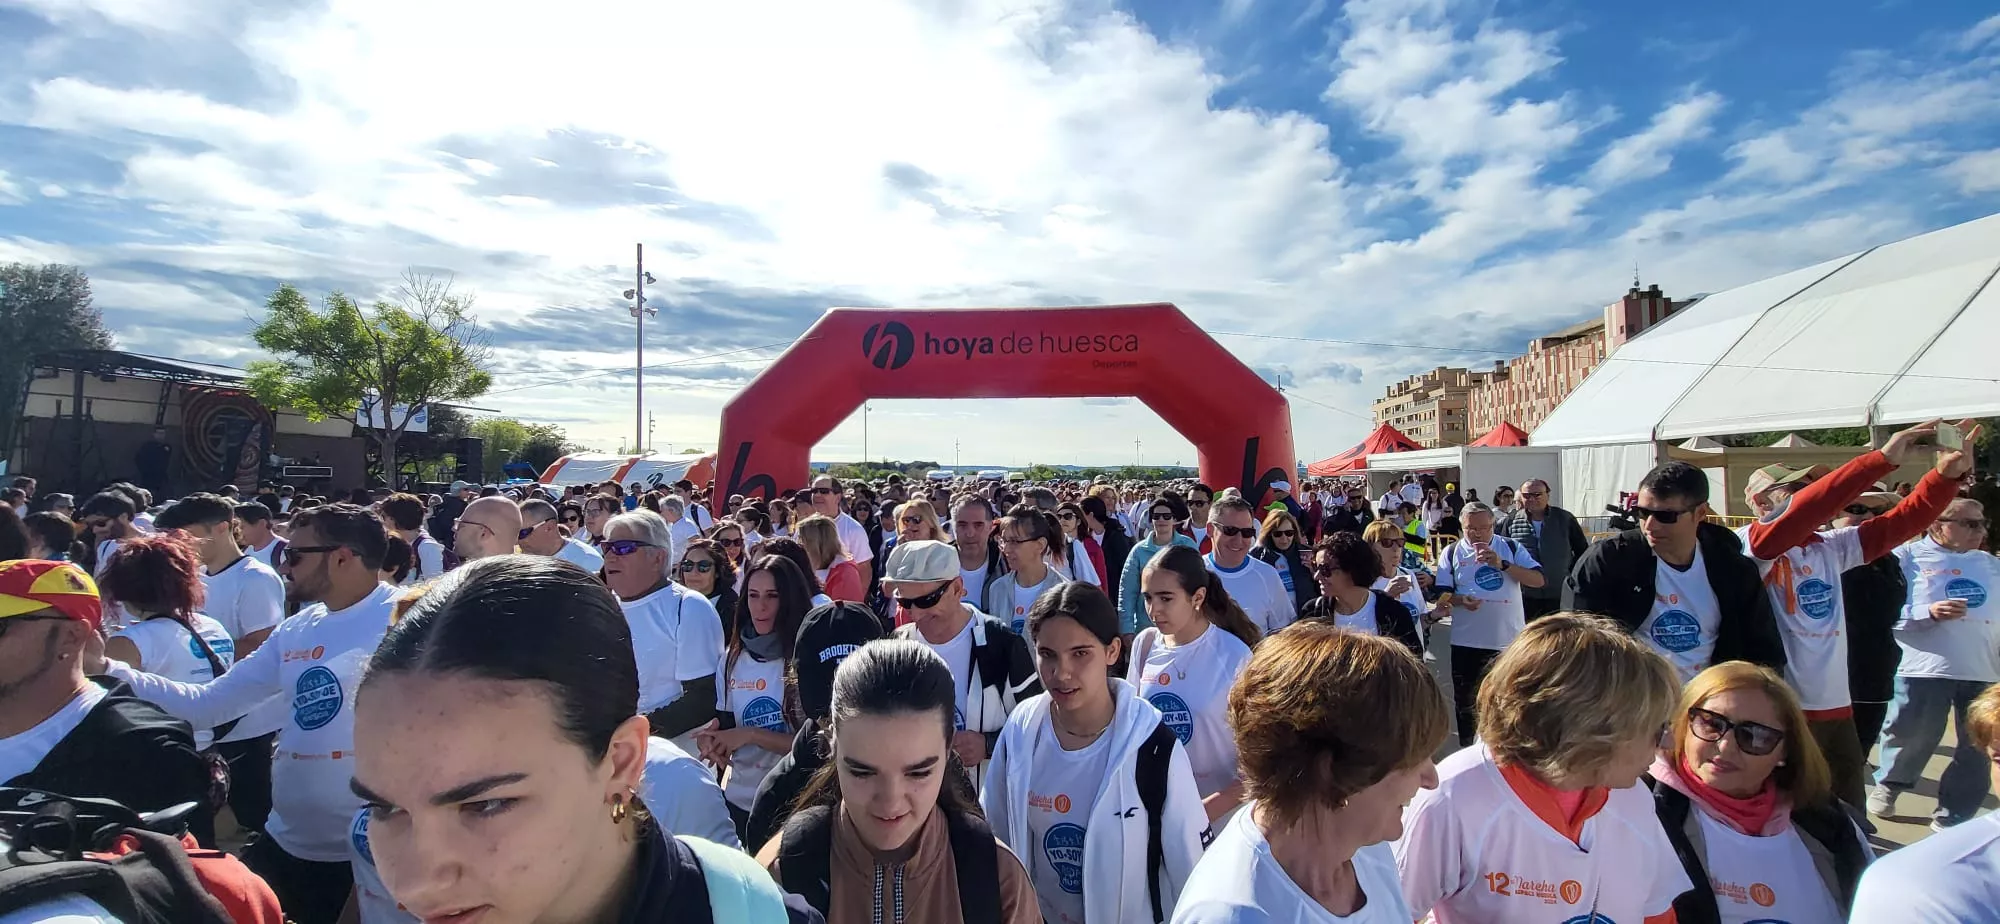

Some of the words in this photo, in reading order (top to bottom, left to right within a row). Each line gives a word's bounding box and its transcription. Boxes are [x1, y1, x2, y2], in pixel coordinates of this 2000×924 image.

[924, 331, 994, 361] hoya
[1000, 330, 1033, 354] de
[1040, 329, 1139, 354] huesca
